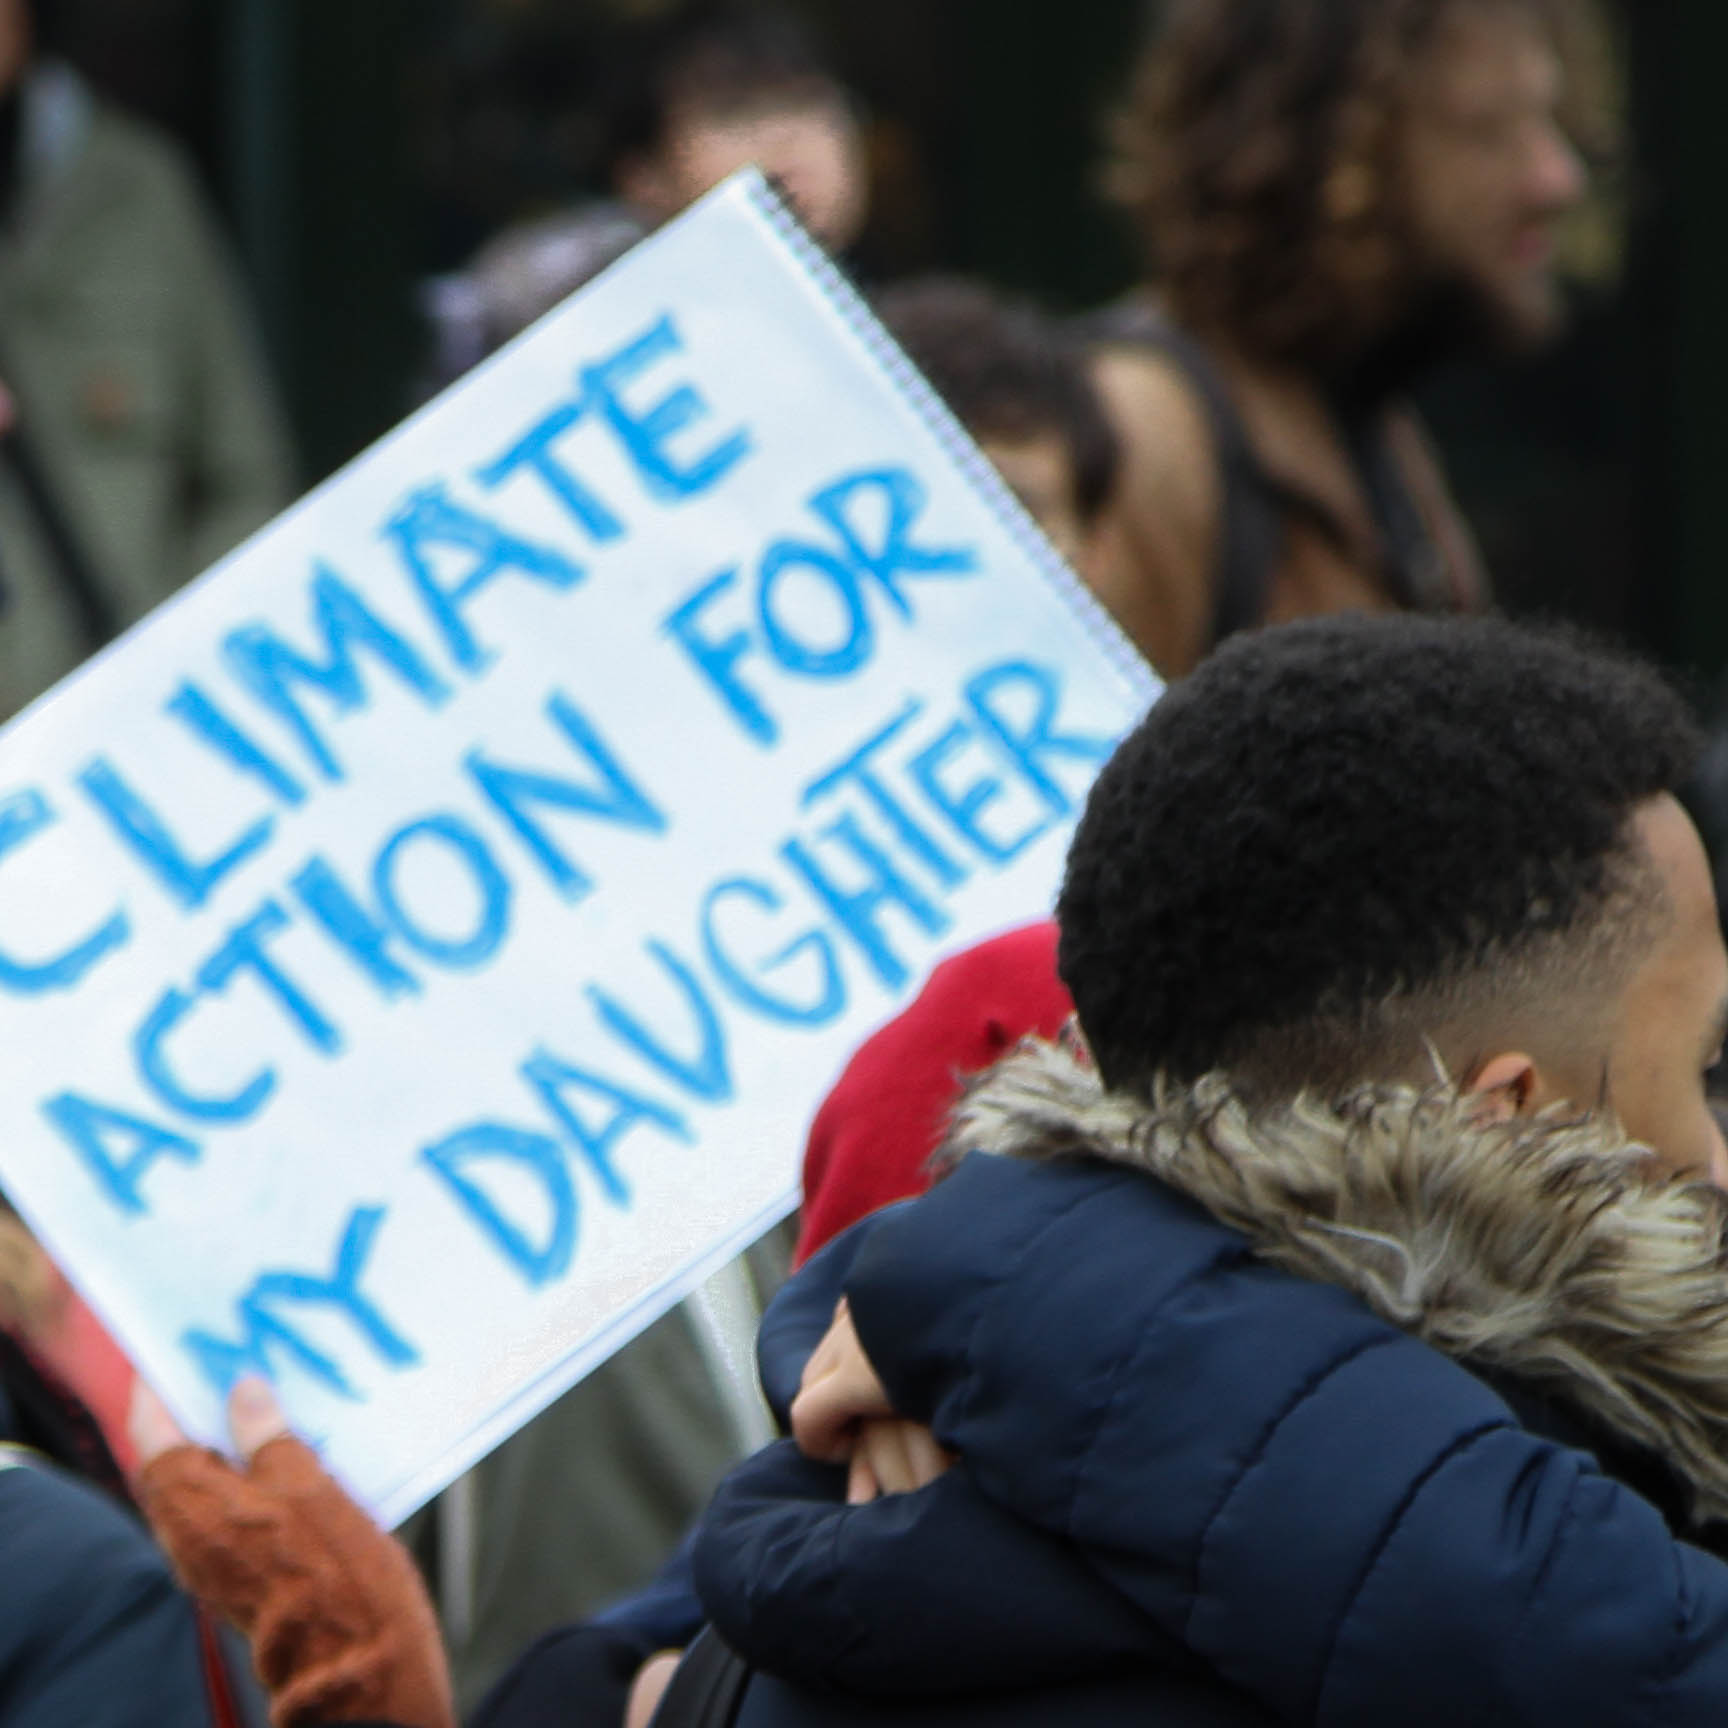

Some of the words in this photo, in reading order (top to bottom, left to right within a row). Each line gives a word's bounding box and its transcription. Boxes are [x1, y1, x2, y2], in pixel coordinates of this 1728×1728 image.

[39, 687, 671, 1219] ACTION
[657, 463, 985, 751] FOR
[178, 1202, 422, 1408] MY
[414, 653, 1122, 1290] DAUGHTER
